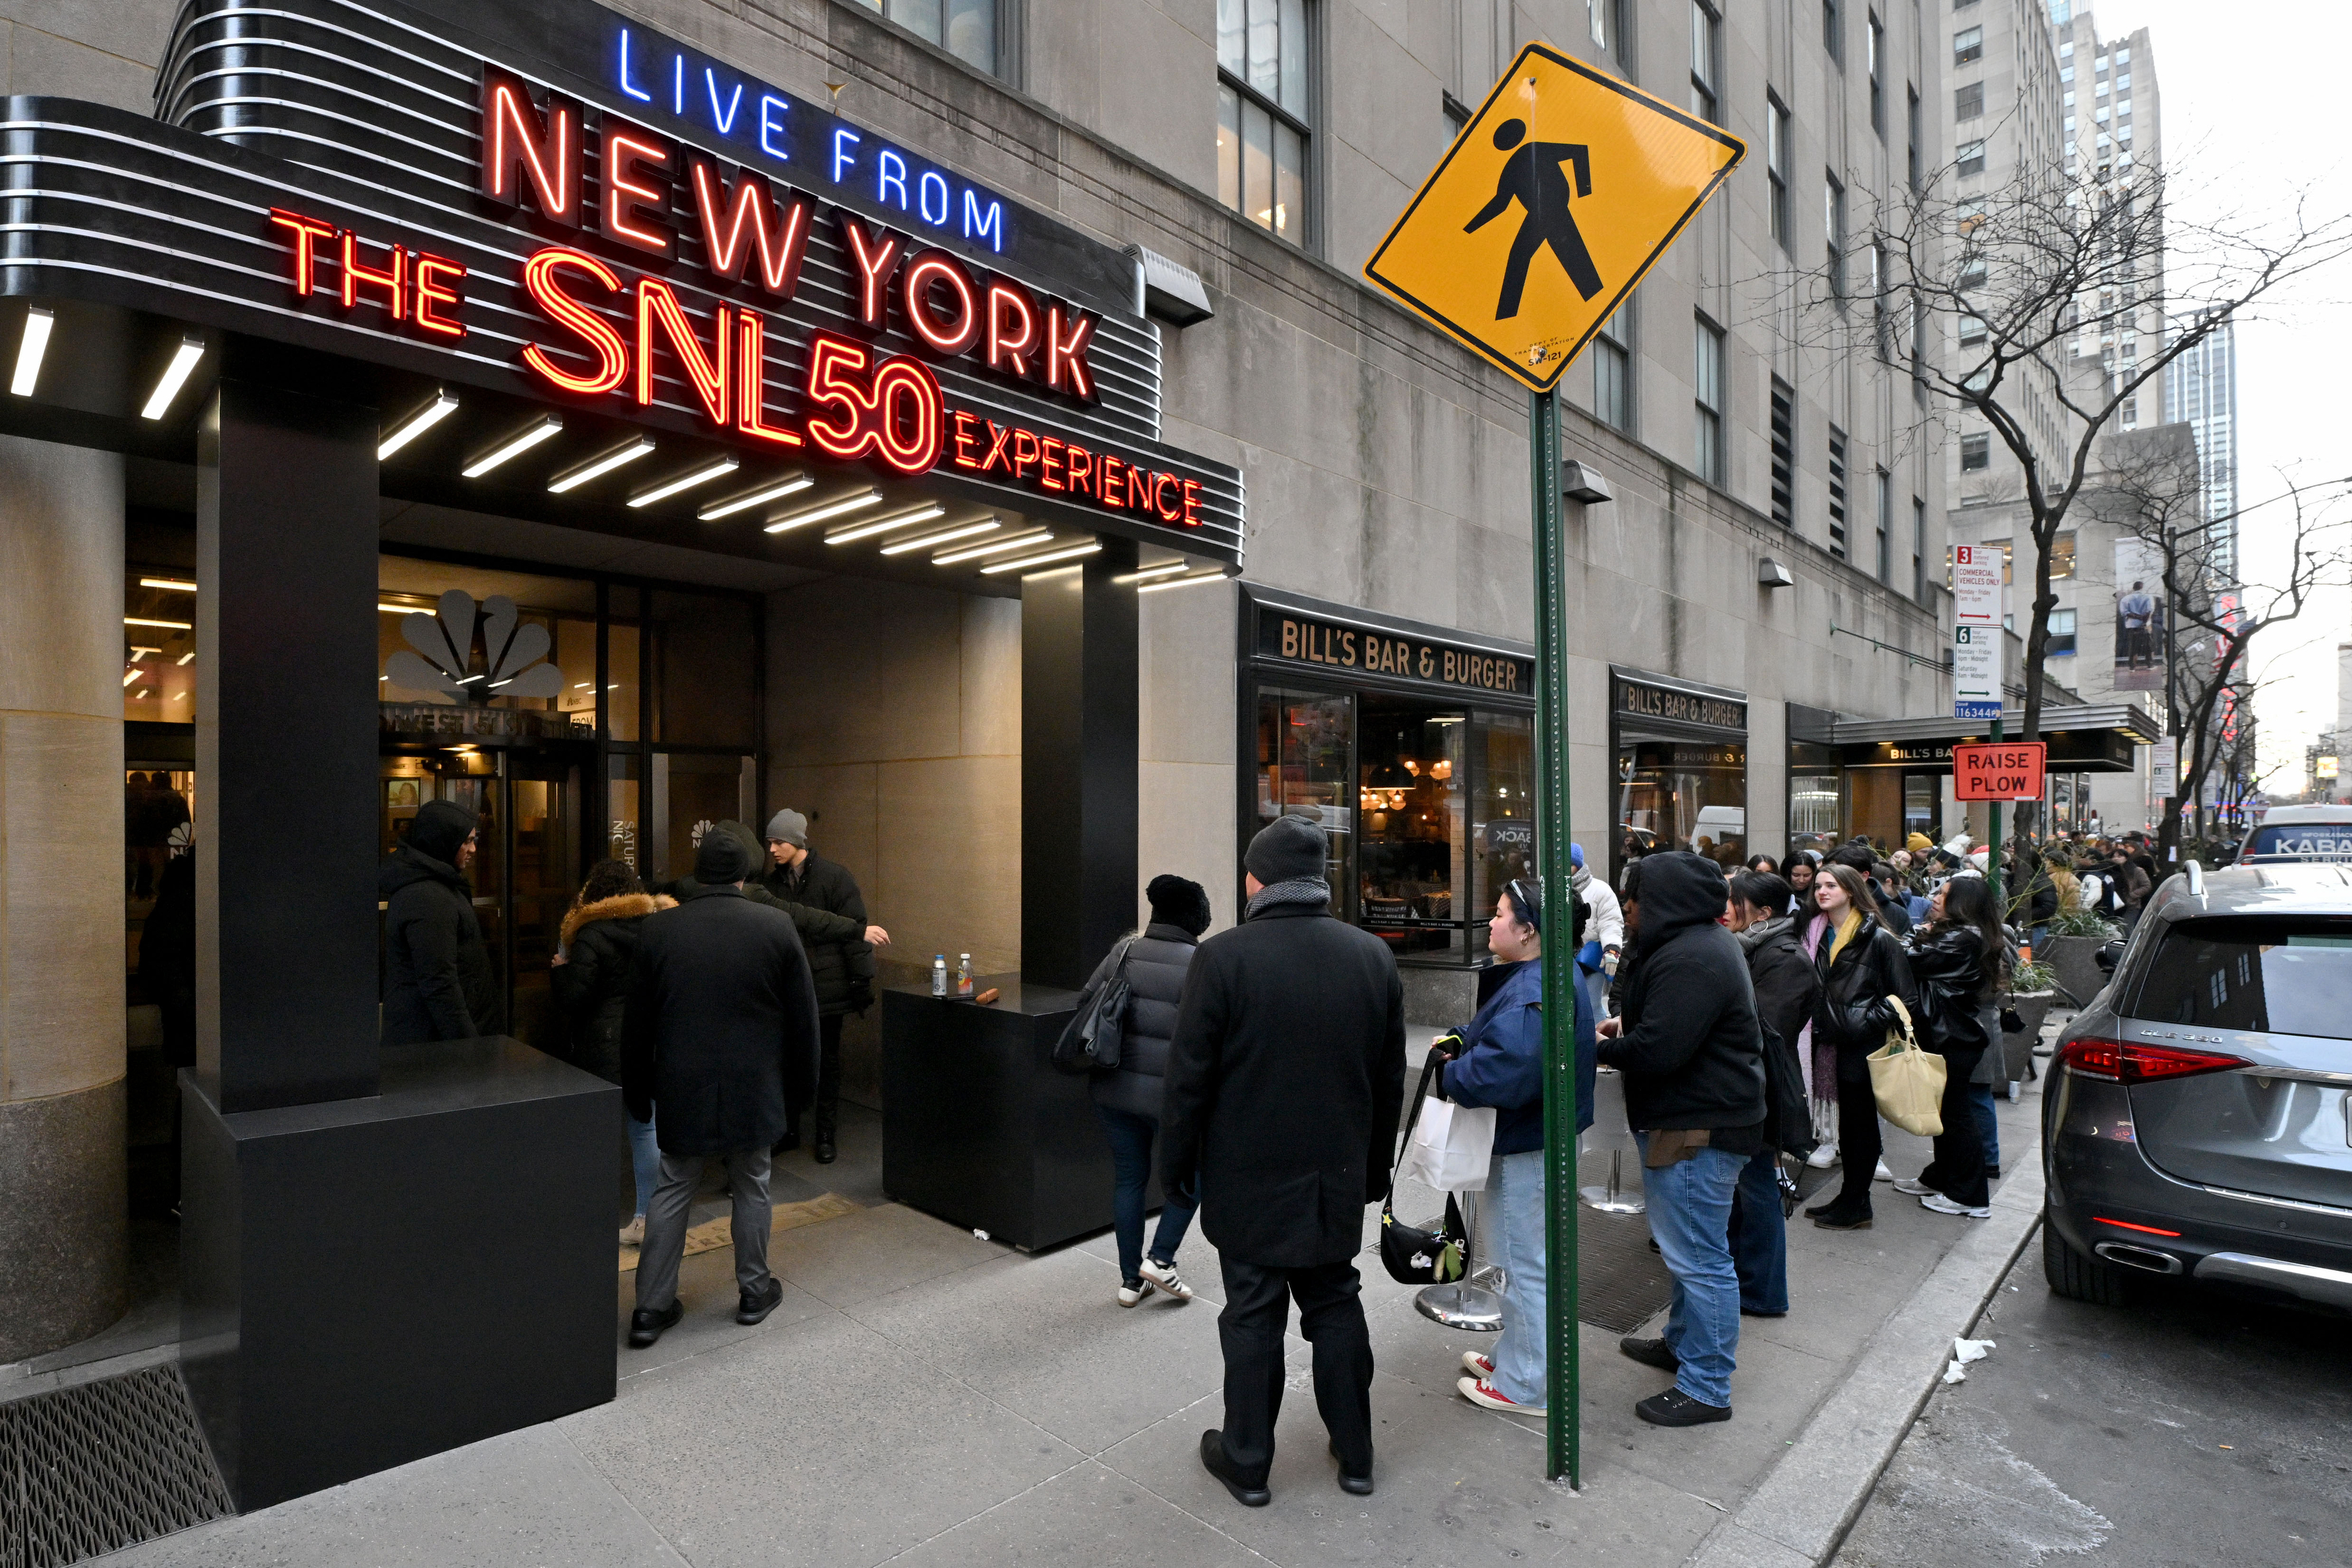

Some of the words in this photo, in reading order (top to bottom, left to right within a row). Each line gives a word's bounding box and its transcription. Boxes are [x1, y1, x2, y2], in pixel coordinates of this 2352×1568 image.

[621, 28, 789, 160] LIVE
[834, 129, 1001, 253] FROM
[482, 60, 818, 300] NEW
[829, 205, 1103, 406] YORK
[1528, 351, 1561, 366] SW-121
[269, 207, 467, 338] THE
[954, 409, 1203, 527] EXPERIENCE
[1960, 548, 1969, 564] 3
[1958, 568, 1994, 577] COMMERCIAL
[1958, 577, 1985, 586] VEHICLES
[1958, 628, 1968, 643] 6
[1282, 619, 1356, 666] BILL'S
[1366, 635, 1410, 676] BAR
[1418, 647, 1435, 679] &
[1443, 650, 1517, 691] BURGER
[1628, 686, 1662, 716] BILL'S
[1664, 693, 1686, 720] BAR
[1690, 699, 1698, 721] &
[1701, 700, 1738, 728] BURGER
[1955, 708, 1991, 717] 116344
[1890, 748, 1931, 760] BILL'S
[1935, 747, 1953, 758] BA
[1967, 753, 2030, 770] RAISE
[1971, 776, 2027, 793] PLOW
[624, 821, 635, 873] SATUR
[2140, 1029, 2178, 1039] GLE
[2182, 1033, 2223, 1044] 350
